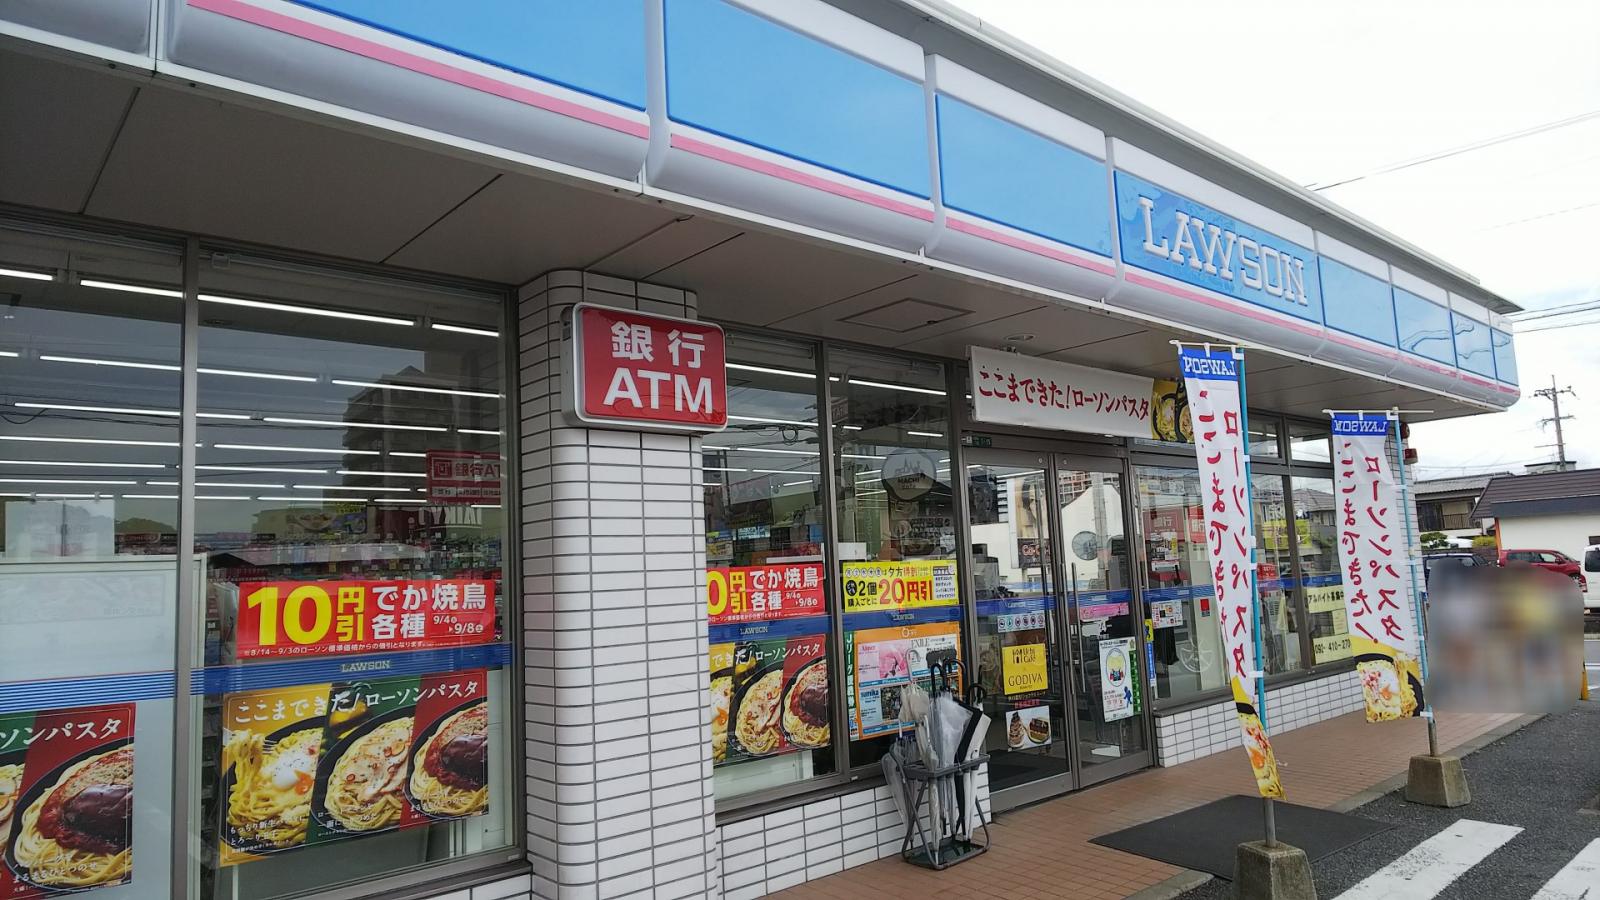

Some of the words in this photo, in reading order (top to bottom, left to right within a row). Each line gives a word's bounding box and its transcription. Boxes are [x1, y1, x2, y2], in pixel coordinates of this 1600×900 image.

[1138, 194, 1308, 306] LAWSON
[610, 320, 706, 369] 銀行
[603, 367, 712, 414] ATM
[749, 567, 819, 590] でか焼鳥
[878, 578, 933, 605] 20円引
[247, 586, 332, 646] 10
[372, 583, 486, 611] でか焼鳥
[751, 591, 783, 612] 各種
[372, 613, 425, 639] 各種
[340, 660, 392, 673] LAWSON
[1008, 672, 1043, 687] GODIVA
